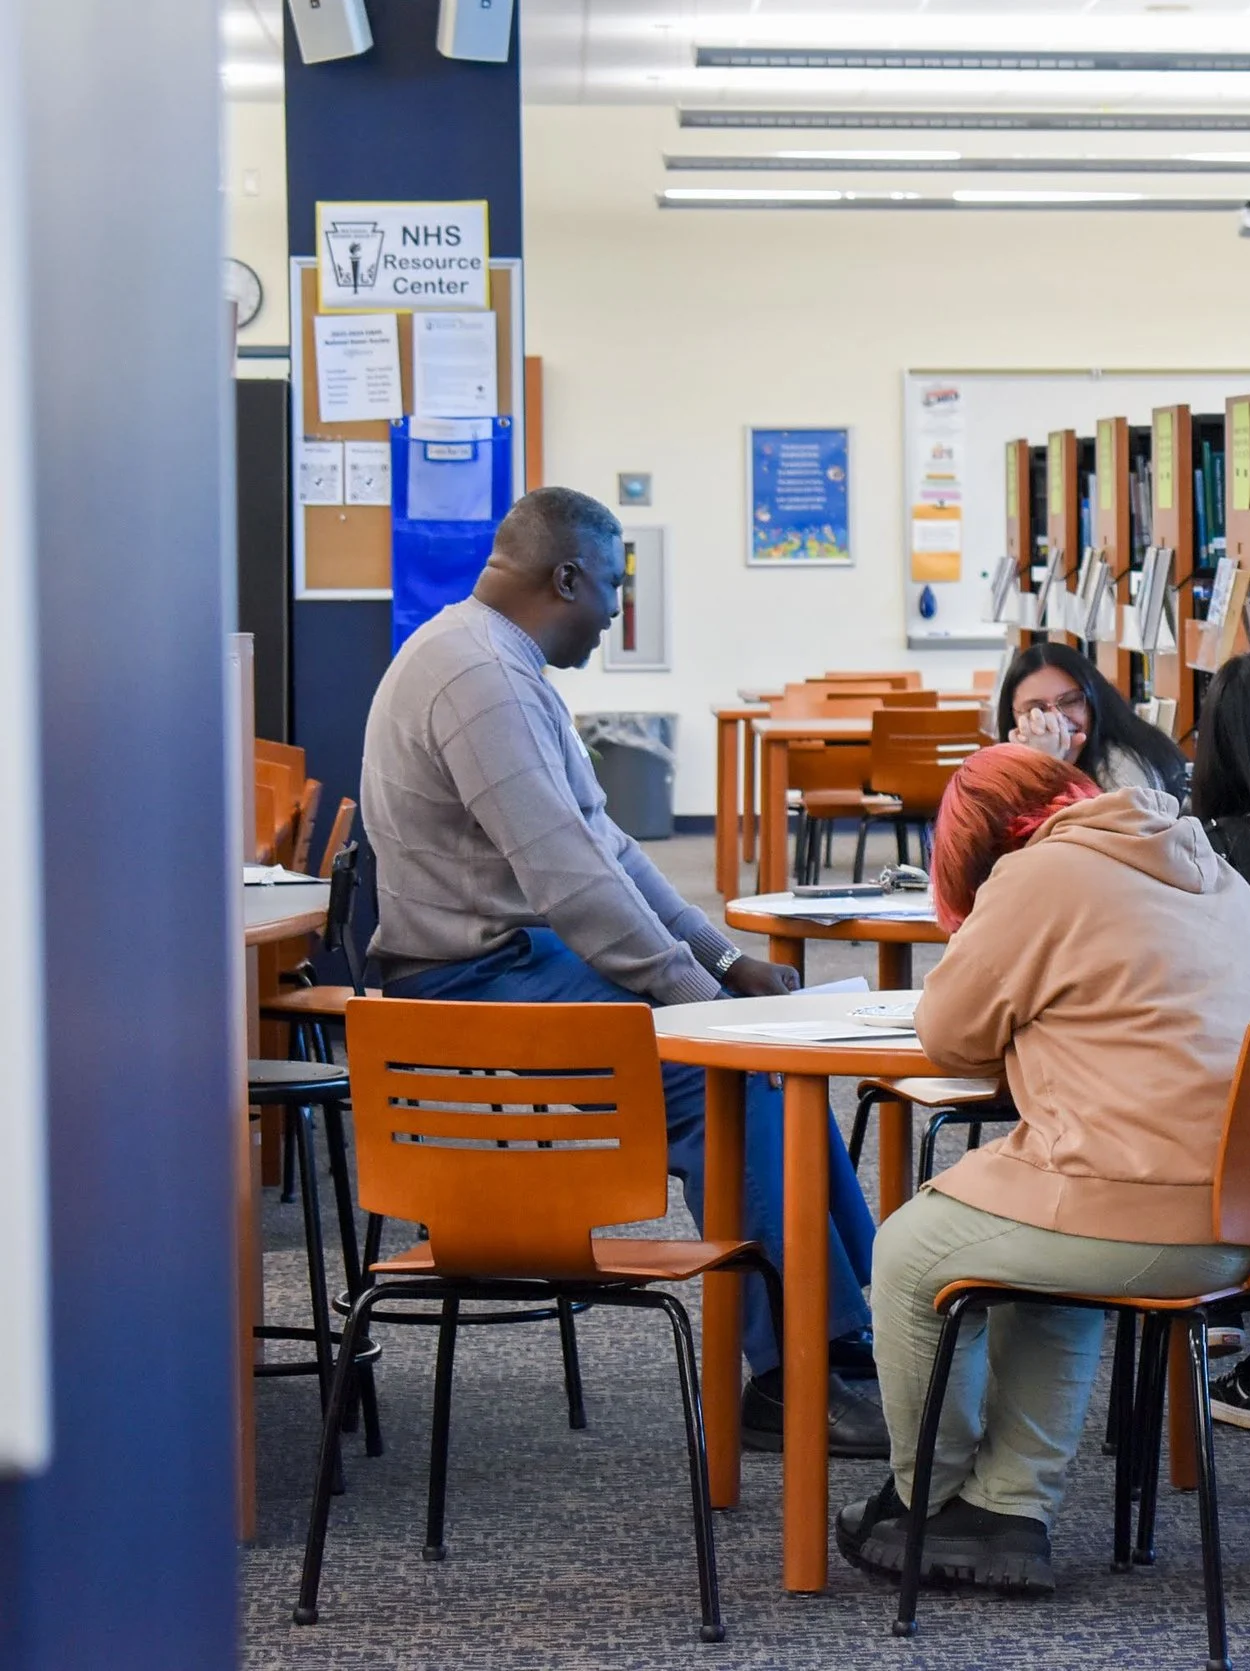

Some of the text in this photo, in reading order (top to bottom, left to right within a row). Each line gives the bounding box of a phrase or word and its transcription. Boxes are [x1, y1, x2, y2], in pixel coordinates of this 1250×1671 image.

[402, 226, 461, 246] NHS
[384, 254, 481, 270] Resource
[393, 277, 470, 294] Center
